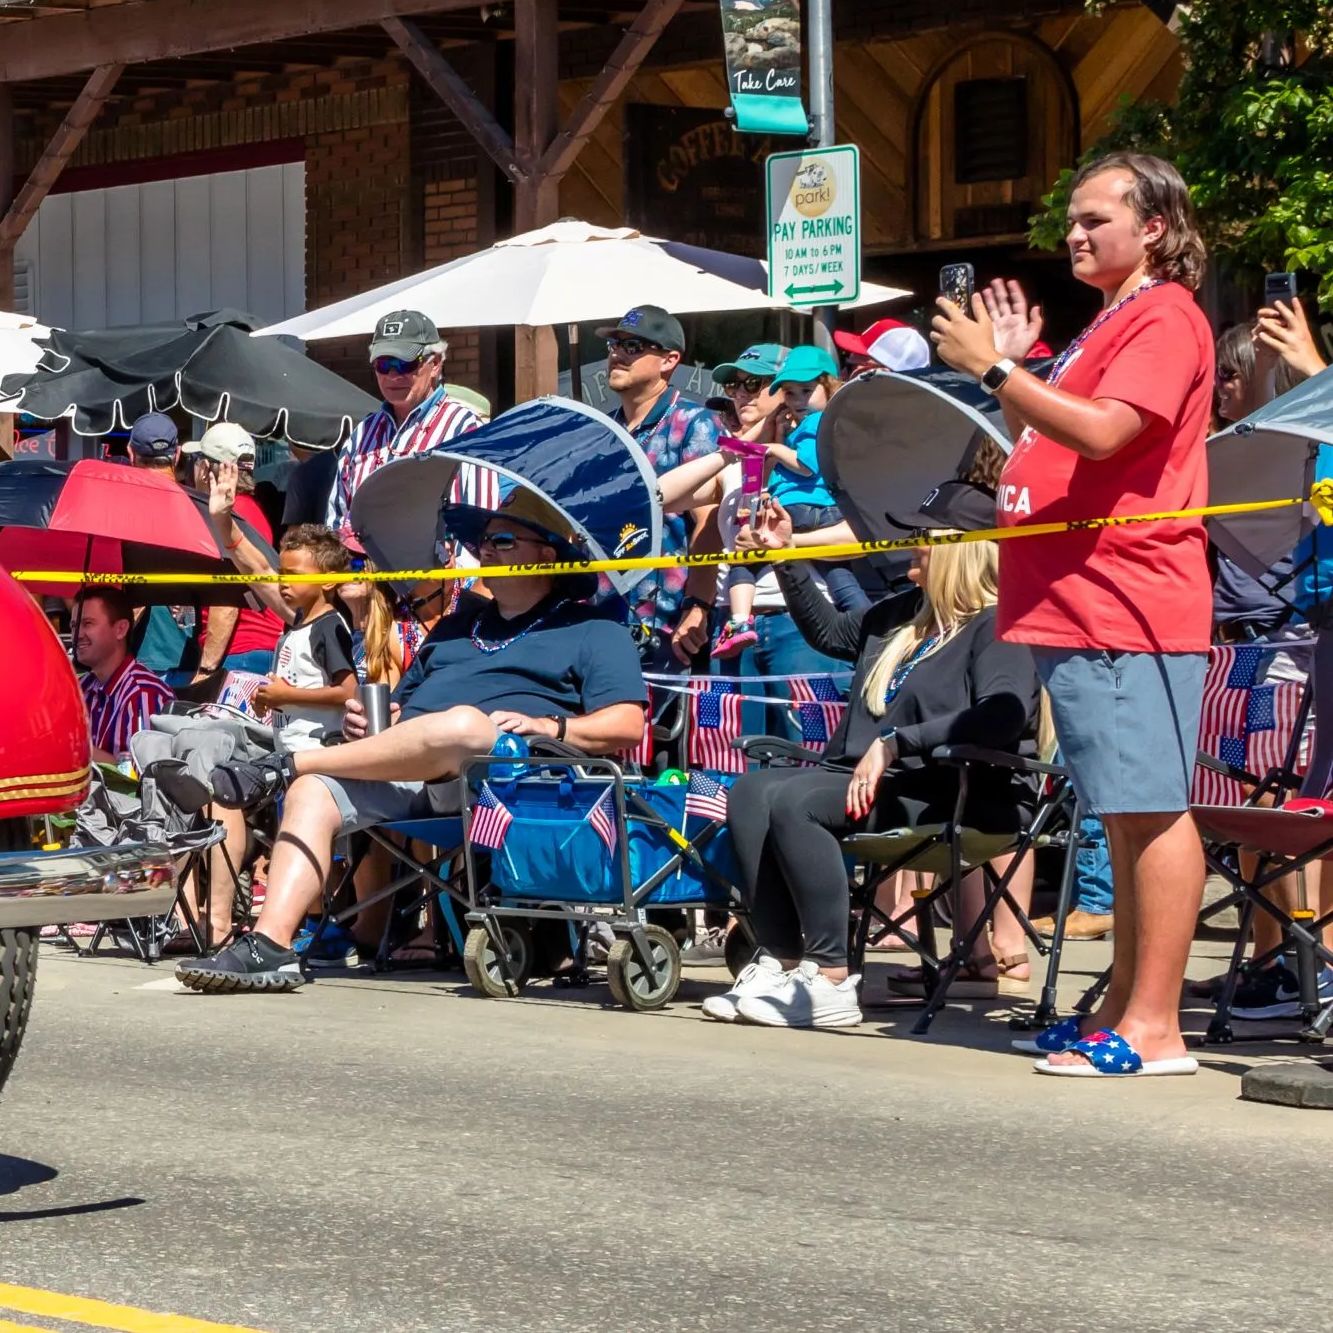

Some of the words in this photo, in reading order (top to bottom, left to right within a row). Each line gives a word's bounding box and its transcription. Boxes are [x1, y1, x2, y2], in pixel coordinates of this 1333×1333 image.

[733, 69, 763, 93] Take
[765, 67, 797, 92] Care
[794, 186, 831, 209] park!
[773, 221, 796, 243] PAY
[801, 214, 853, 240] PARKING
[785, 249, 793, 260] 10
[795, 247, 807, 259] AM
[810, 247, 819, 258] to
[822, 246, 829, 257] 6
[830, 244, 842, 256] PM
[783, 265, 789, 277] 7
